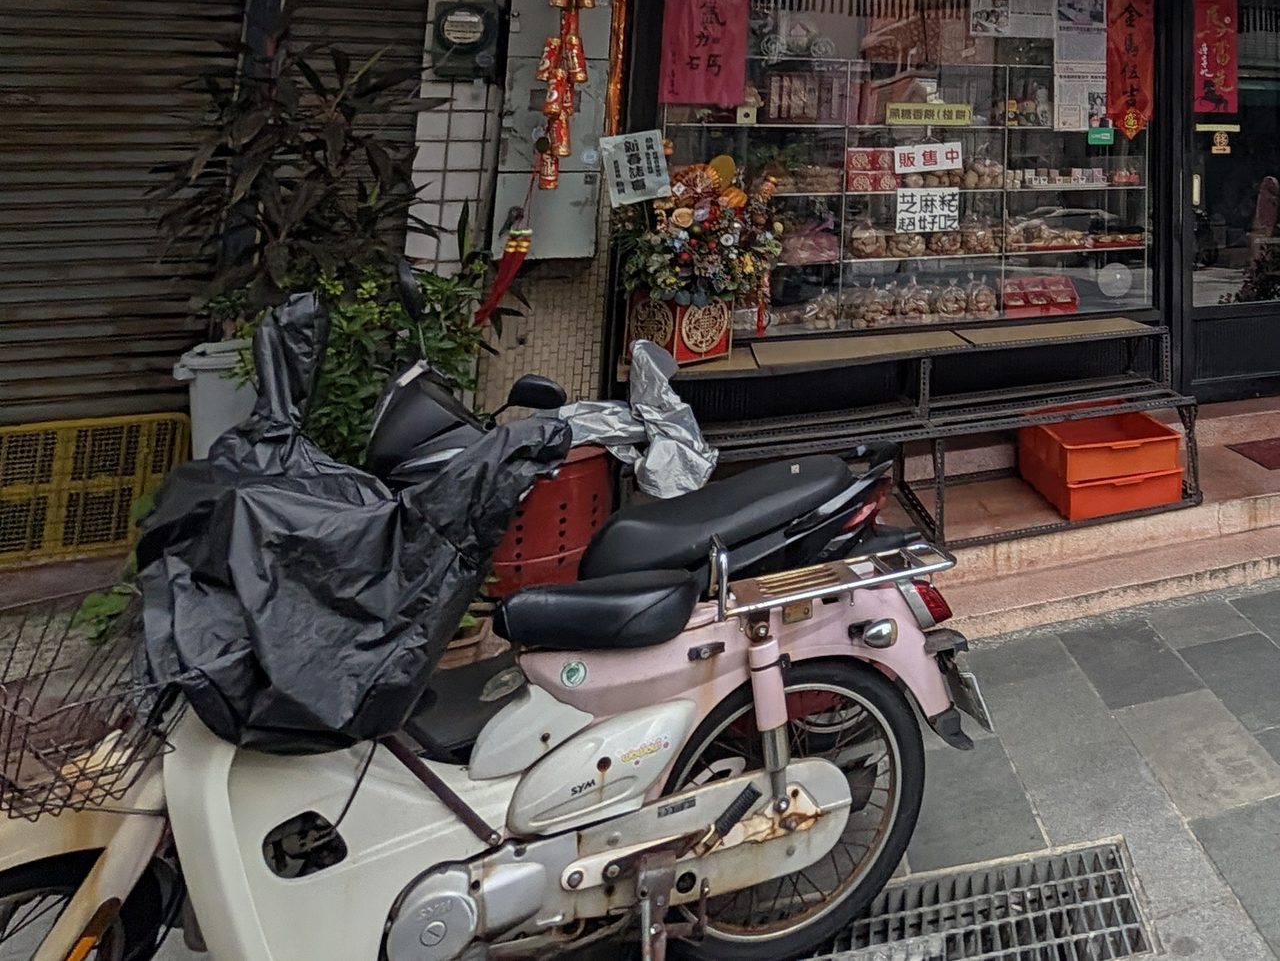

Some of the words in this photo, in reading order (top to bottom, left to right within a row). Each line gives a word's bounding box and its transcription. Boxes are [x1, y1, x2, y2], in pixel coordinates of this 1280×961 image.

[899, 148, 960, 168] 販售中
[898, 214, 959, 232] 超好吃
[570, 778, 597, 796] SYM
